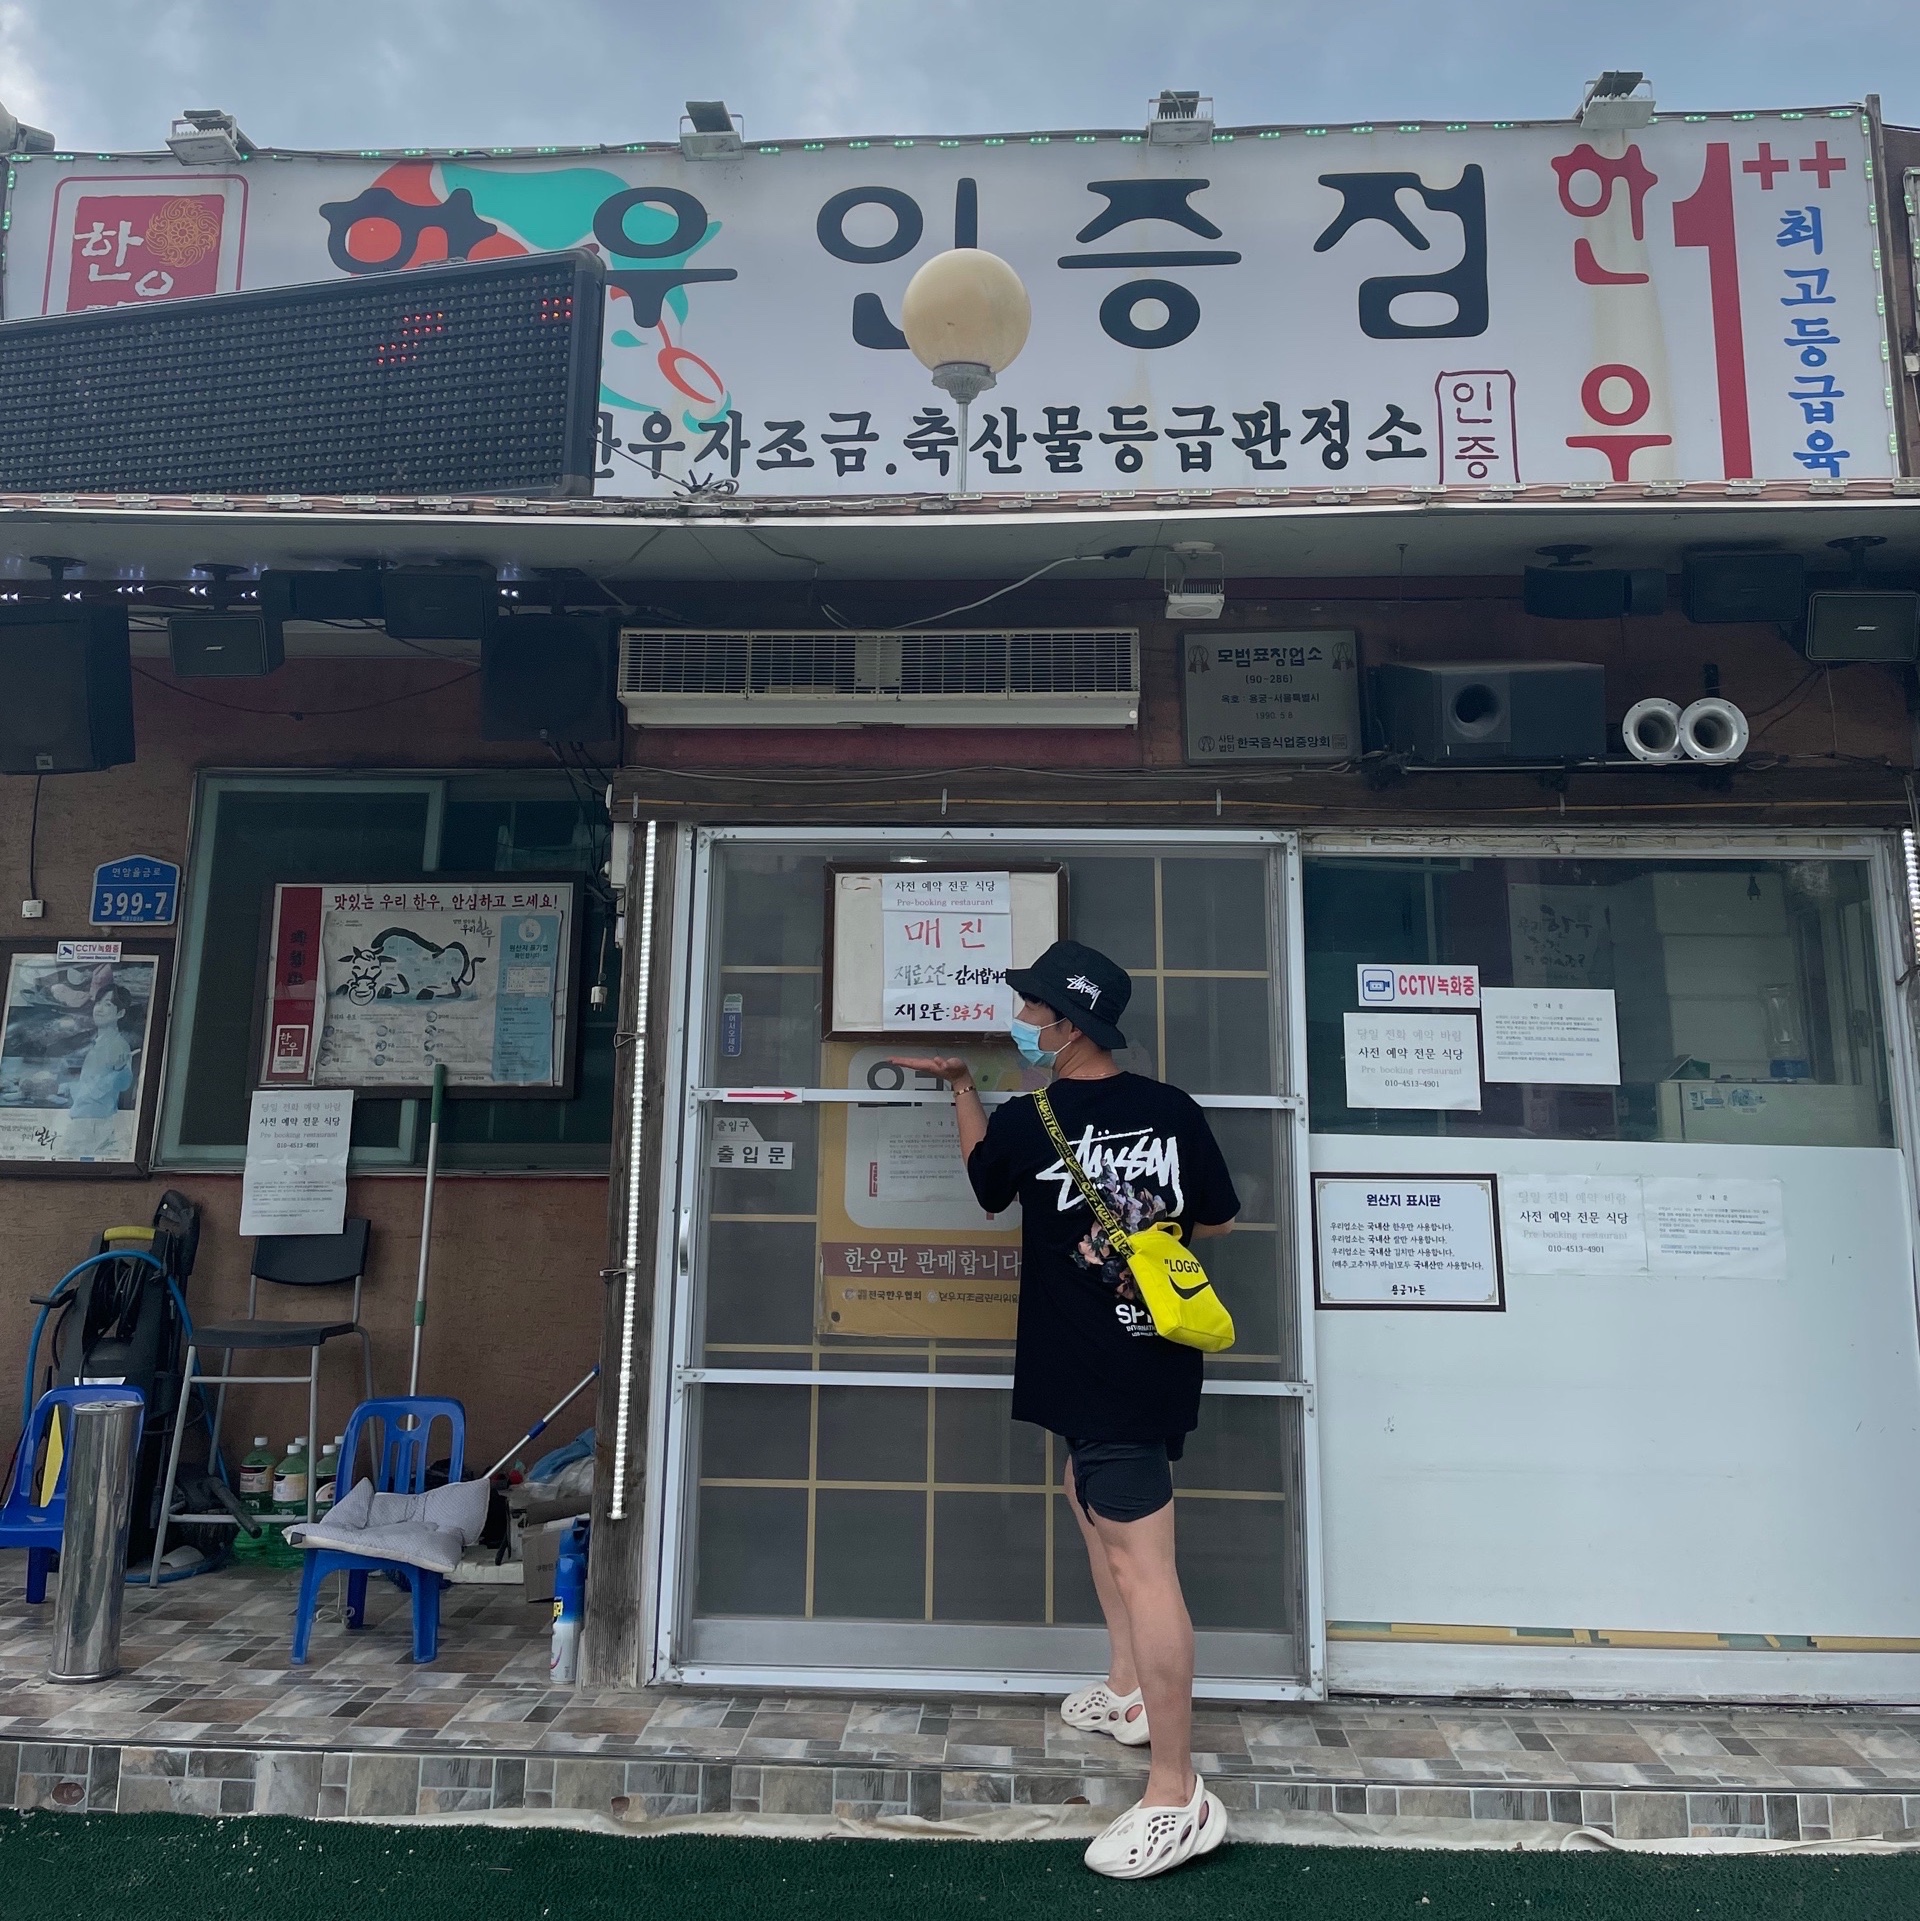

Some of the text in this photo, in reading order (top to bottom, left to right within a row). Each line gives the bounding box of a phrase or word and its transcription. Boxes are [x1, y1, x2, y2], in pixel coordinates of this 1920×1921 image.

[1551, 143, 1673, 481] 한우
[1776, 206, 1851, 478] 최고등급육
[1453, 381, 1499, 479] 인증
[1245, 674, 1293, 684] (90-286)
[1237, 735, 1330, 749] 한국음식업중앙회
[895, 880, 996, 893] 사전 예약 전문 식당
[100, 892, 167, 916] 399-7
[334, 893, 558, 911] 맛있는 우리 한우, 안심하고 드세요!
[897, 898, 994, 908] Pre-booking restaurant
[1386, 1029, 1406, 1041] 전화
[1413, 1029, 1434, 1041] 예약
[1440, 1030, 1462, 1042] 바람
[1358, 1047, 1464, 1061] 사전 예약 전문 식당
[1361, 1066, 1462, 1076] Pre booking restaurant
[1384, 1079, 1440, 1088] 010-4513-4901
[304, 1102, 320, 1112] 예약
[260, 1116, 341, 1127] 사전 예약 전문 식당
[1366, 1194, 1441, 1207] 원산지 표시판
[1576, 1192, 1597, 1204] 예약
[1520, 1211, 1628, 1225] 사전 예약 전문 식당
[1330, 1222, 1364, 1231] 우리업소는
[1367, 1222, 1390, 1231] 국내산
[1392, 1222, 1414, 1231] 한우만
[1331, 1235, 1365, 1244] 우리업소는
[1368, 1235, 1391, 1244] 국내산
[1543, 1230, 1577, 1240] booking
[1582, 1232, 1627, 1240] restaurant
[1332, 1247, 1366, 1256] 우리업소는
[1368, 1247, 1391, 1256] 국내산
[1394, 1247, 1415, 1257] 김치만
[1548, 1245, 1604, 1253] 010-4513-4901
[844, 1247, 1022, 1278] 한우만 판매합니다
[1413, 1261, 1444, 1270] 국내산만
[1391, 1284, 1426, 1296] 용궁가든
